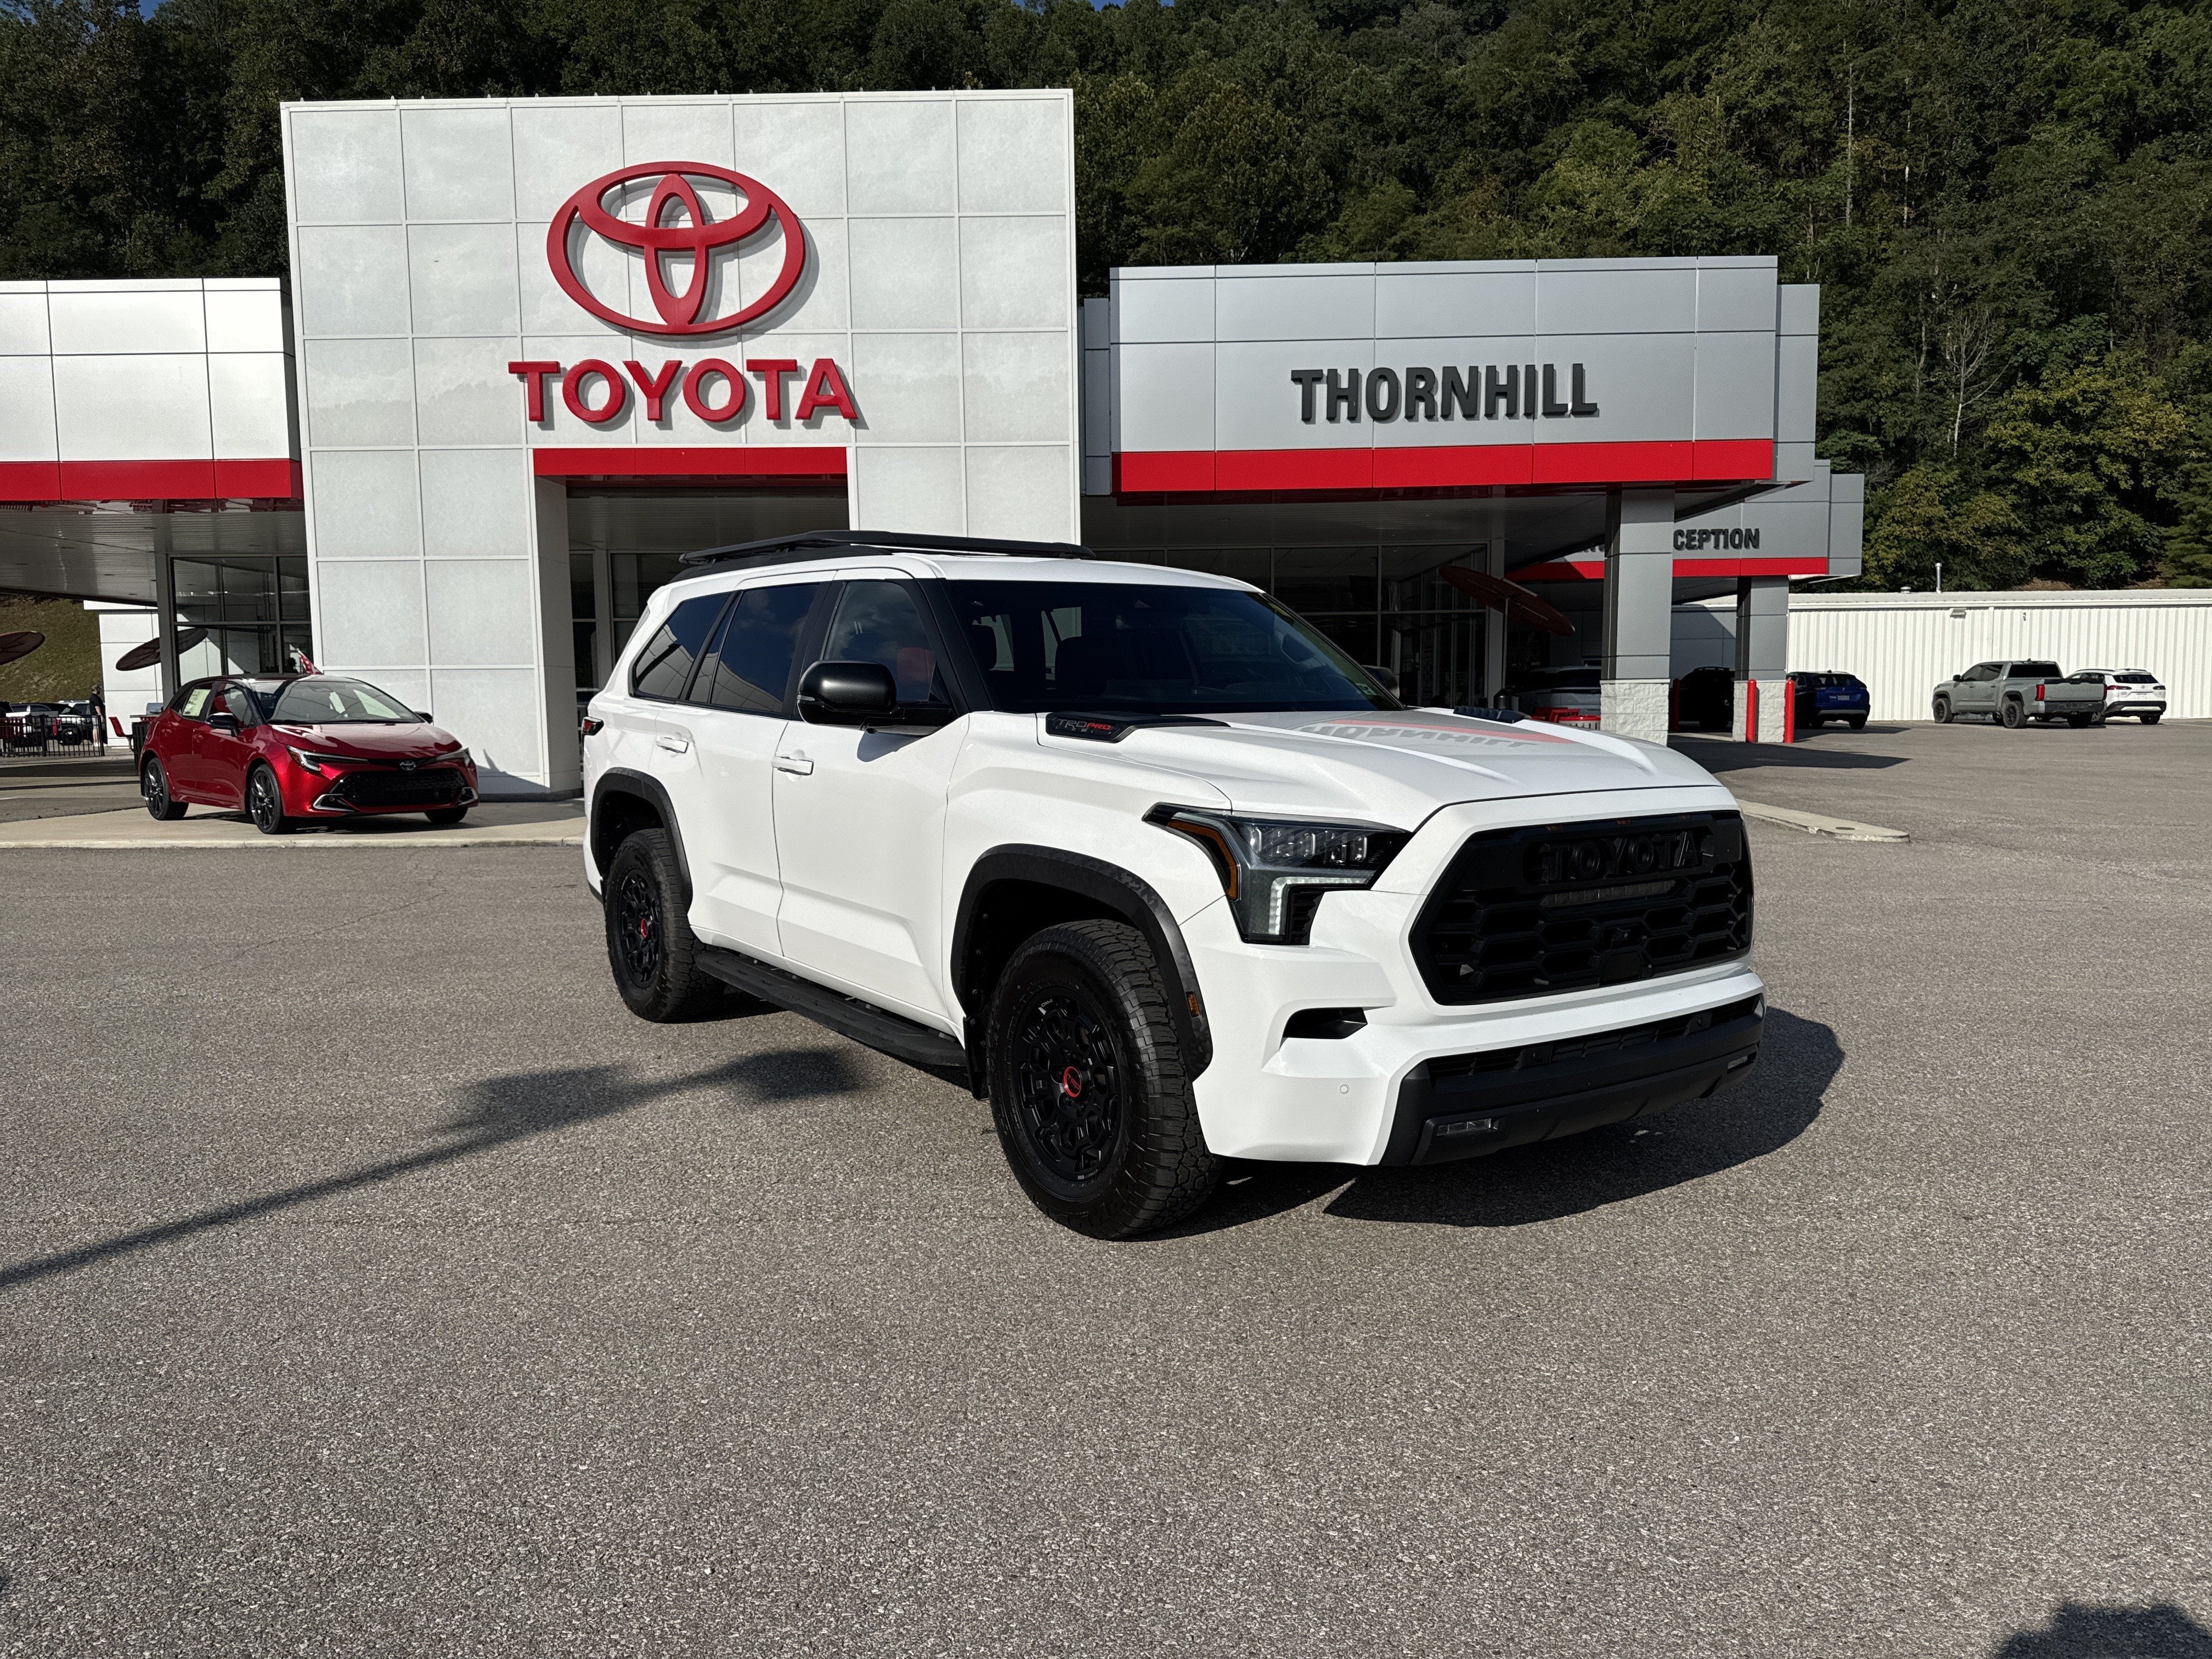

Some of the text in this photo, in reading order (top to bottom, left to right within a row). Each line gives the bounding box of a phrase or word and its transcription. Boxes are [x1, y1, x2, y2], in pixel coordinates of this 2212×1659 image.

[508, 358, 858, 422] TOYOTA
[1291, 363, 1597, 421] THORNHILL
[1542, 831, 1701, 881] TOYOTA
